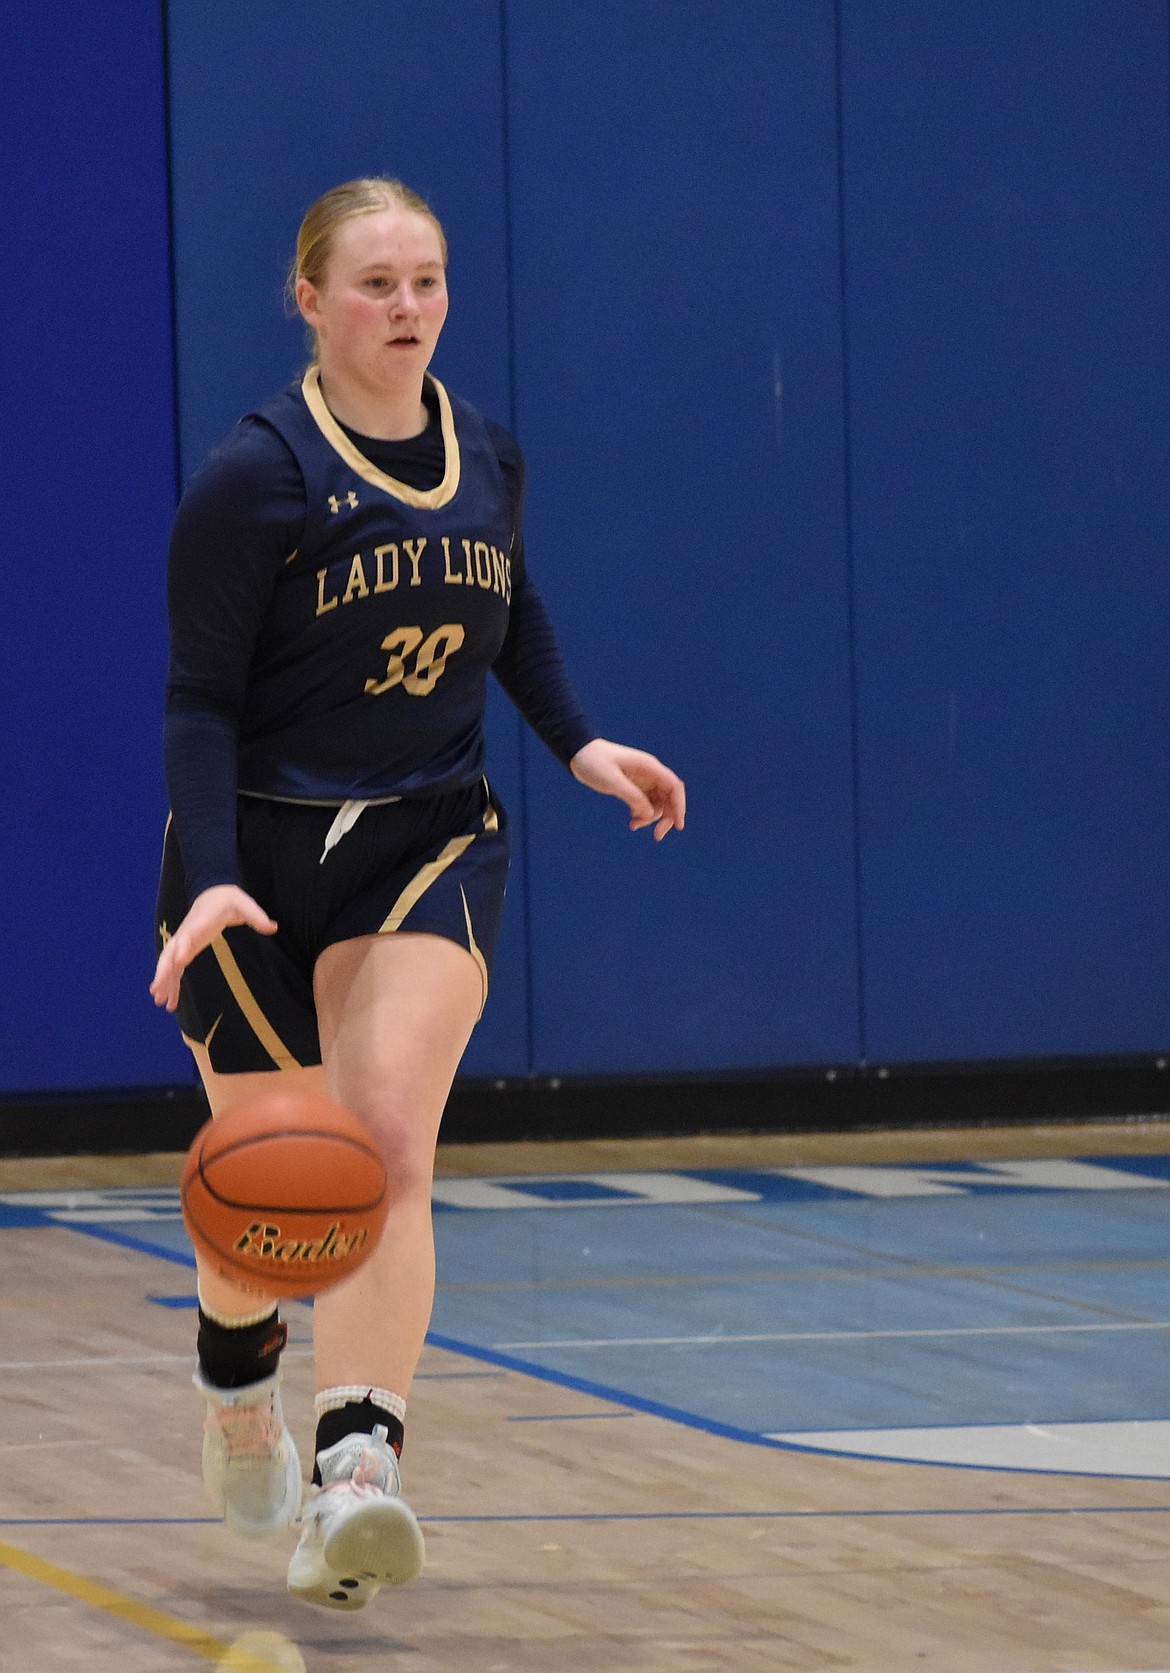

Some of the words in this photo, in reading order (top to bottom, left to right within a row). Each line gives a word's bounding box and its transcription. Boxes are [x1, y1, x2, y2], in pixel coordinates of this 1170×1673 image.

[316, 537, 426, 616] LADY
[364, 624, 465, 697] 30
[233, 1221, 369, 1262] Baden
